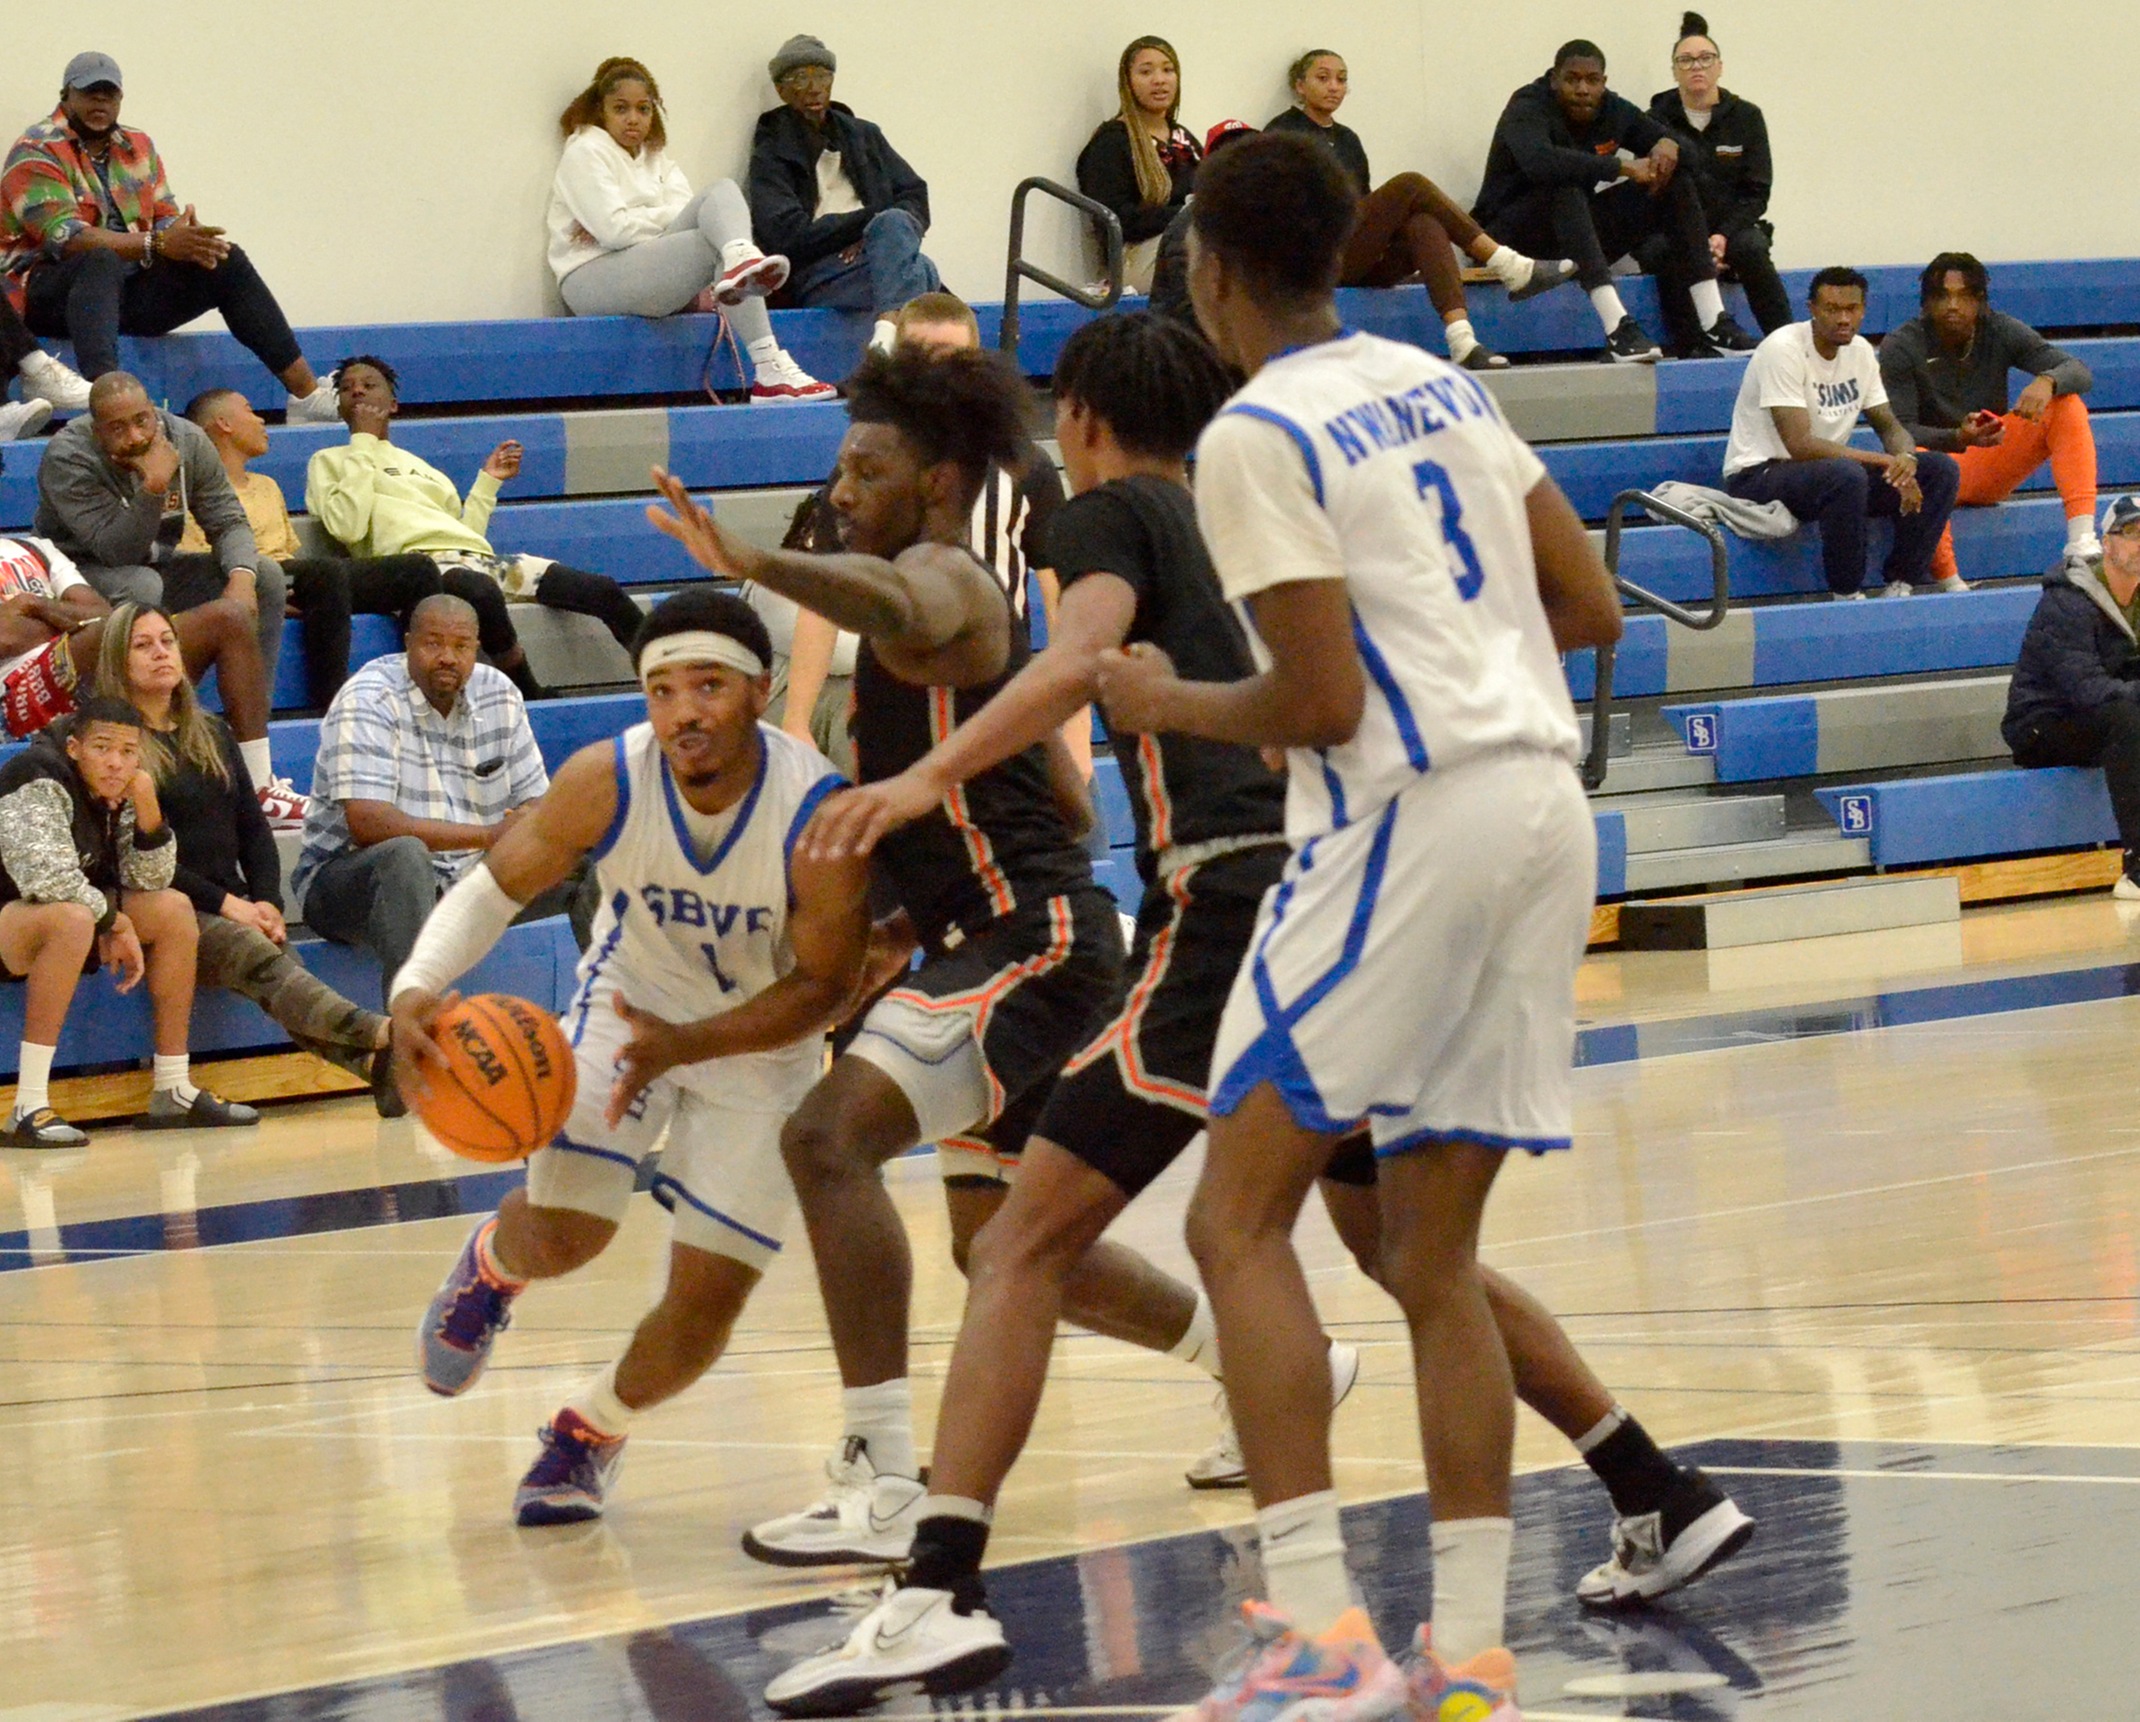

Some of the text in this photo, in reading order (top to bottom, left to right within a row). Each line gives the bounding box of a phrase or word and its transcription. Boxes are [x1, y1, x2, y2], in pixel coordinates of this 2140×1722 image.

[1412, 459, 1485, 602] 3
[701, 942, 737, 993] 1
[451, 1018, 509, 1087] NCAA
